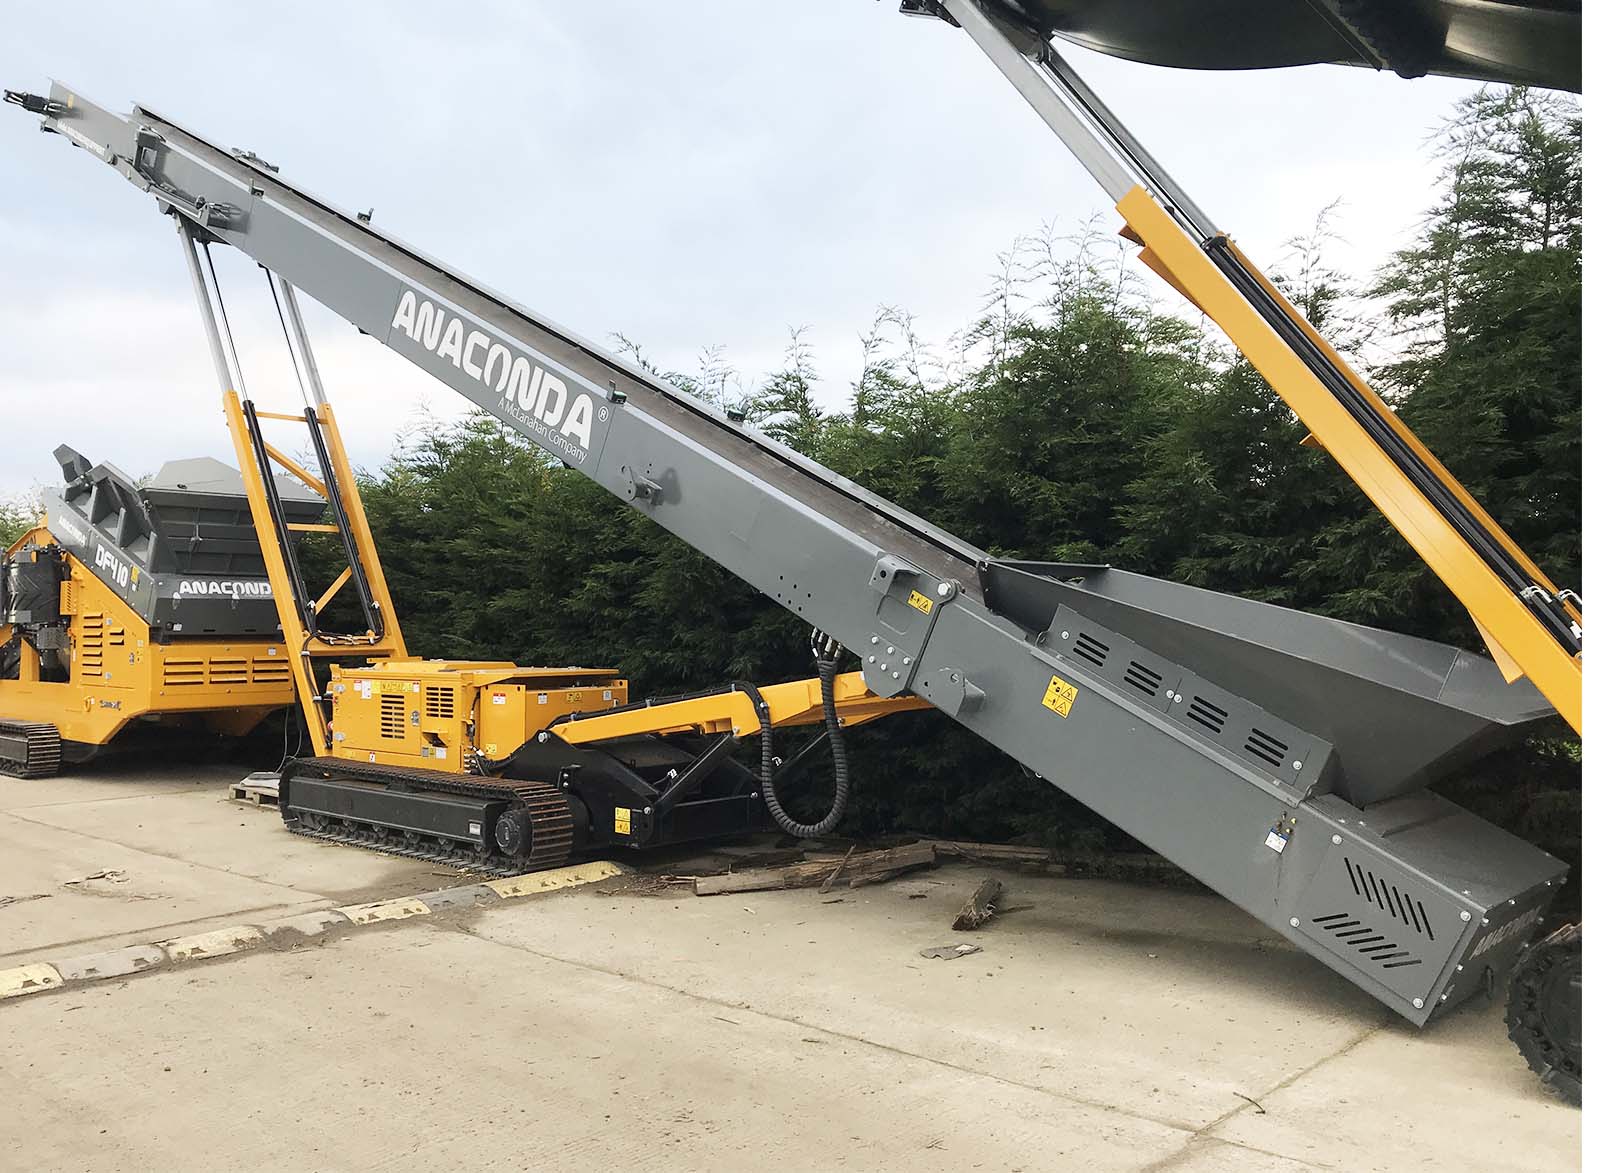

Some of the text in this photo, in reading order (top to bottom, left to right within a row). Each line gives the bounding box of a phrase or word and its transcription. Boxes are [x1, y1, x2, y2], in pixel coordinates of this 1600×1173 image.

[391, 290, 594, 450] ANACONDA
[498, 397, 587, 464] A McLanahan Company
[95, 543, 129, 588] DF410
[179, 580, 272, 595] ANACOND
